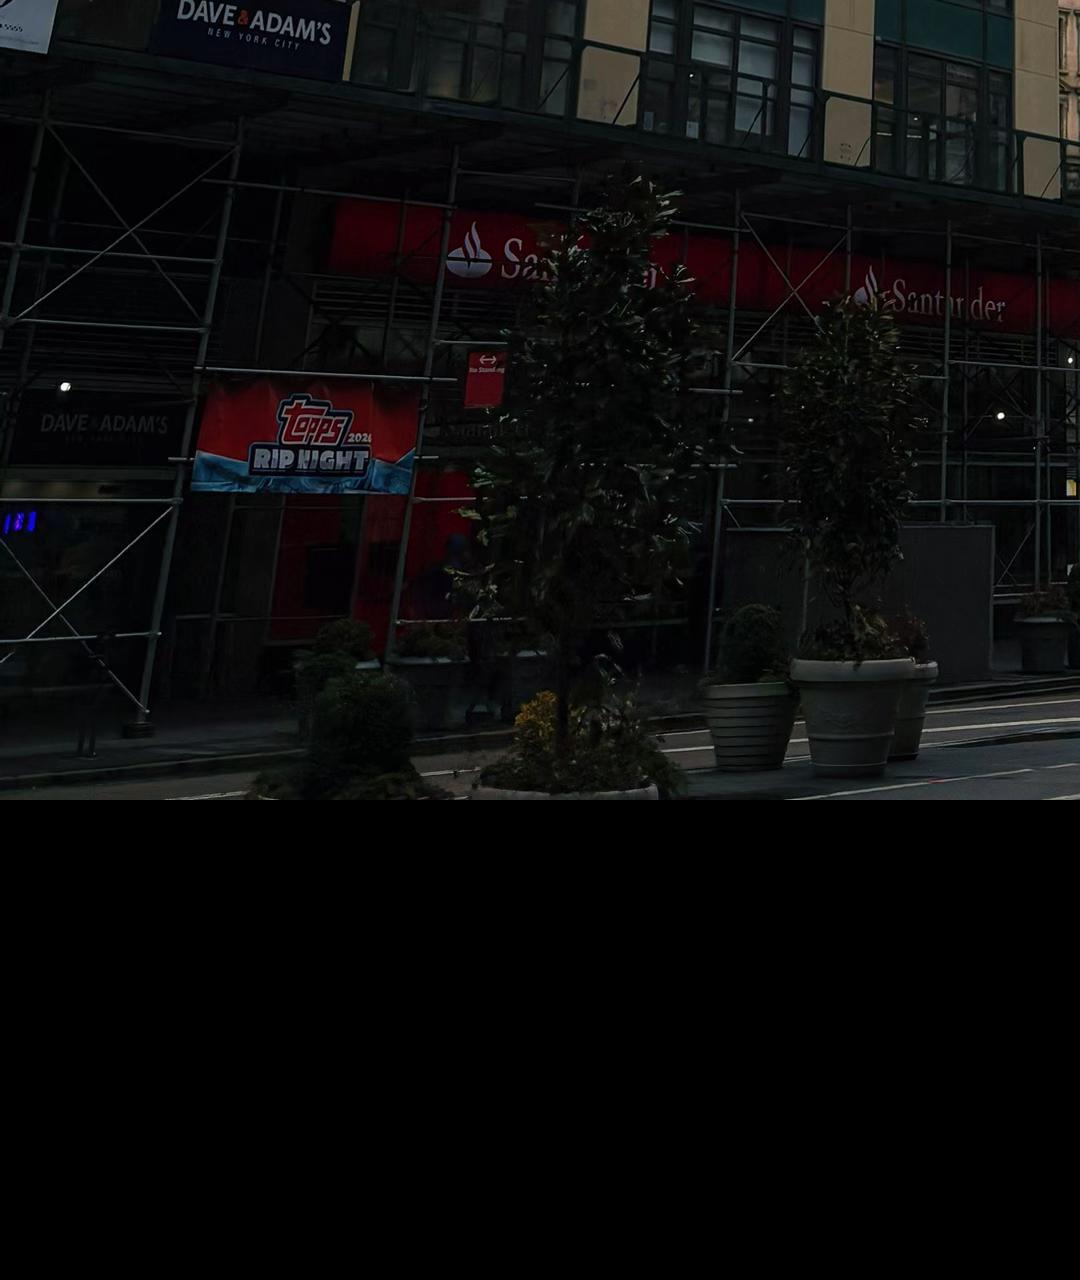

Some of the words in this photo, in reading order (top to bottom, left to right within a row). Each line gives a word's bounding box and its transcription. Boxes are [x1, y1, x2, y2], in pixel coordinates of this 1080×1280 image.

[237, 8, 250, 26] &
[249, 9, 332, 46] ADAM'S
[207, 27, 232, 40] NEW
[238, 31, 268, 45] YORK
[274, 38, 301, 51] CITY
[39, 413, 89, 433] DAVE
[98, 414, 169, 434] ADAM'S
[253, 448, 295, 470] RIP
[300, 448, 370, 471] NIGHT
